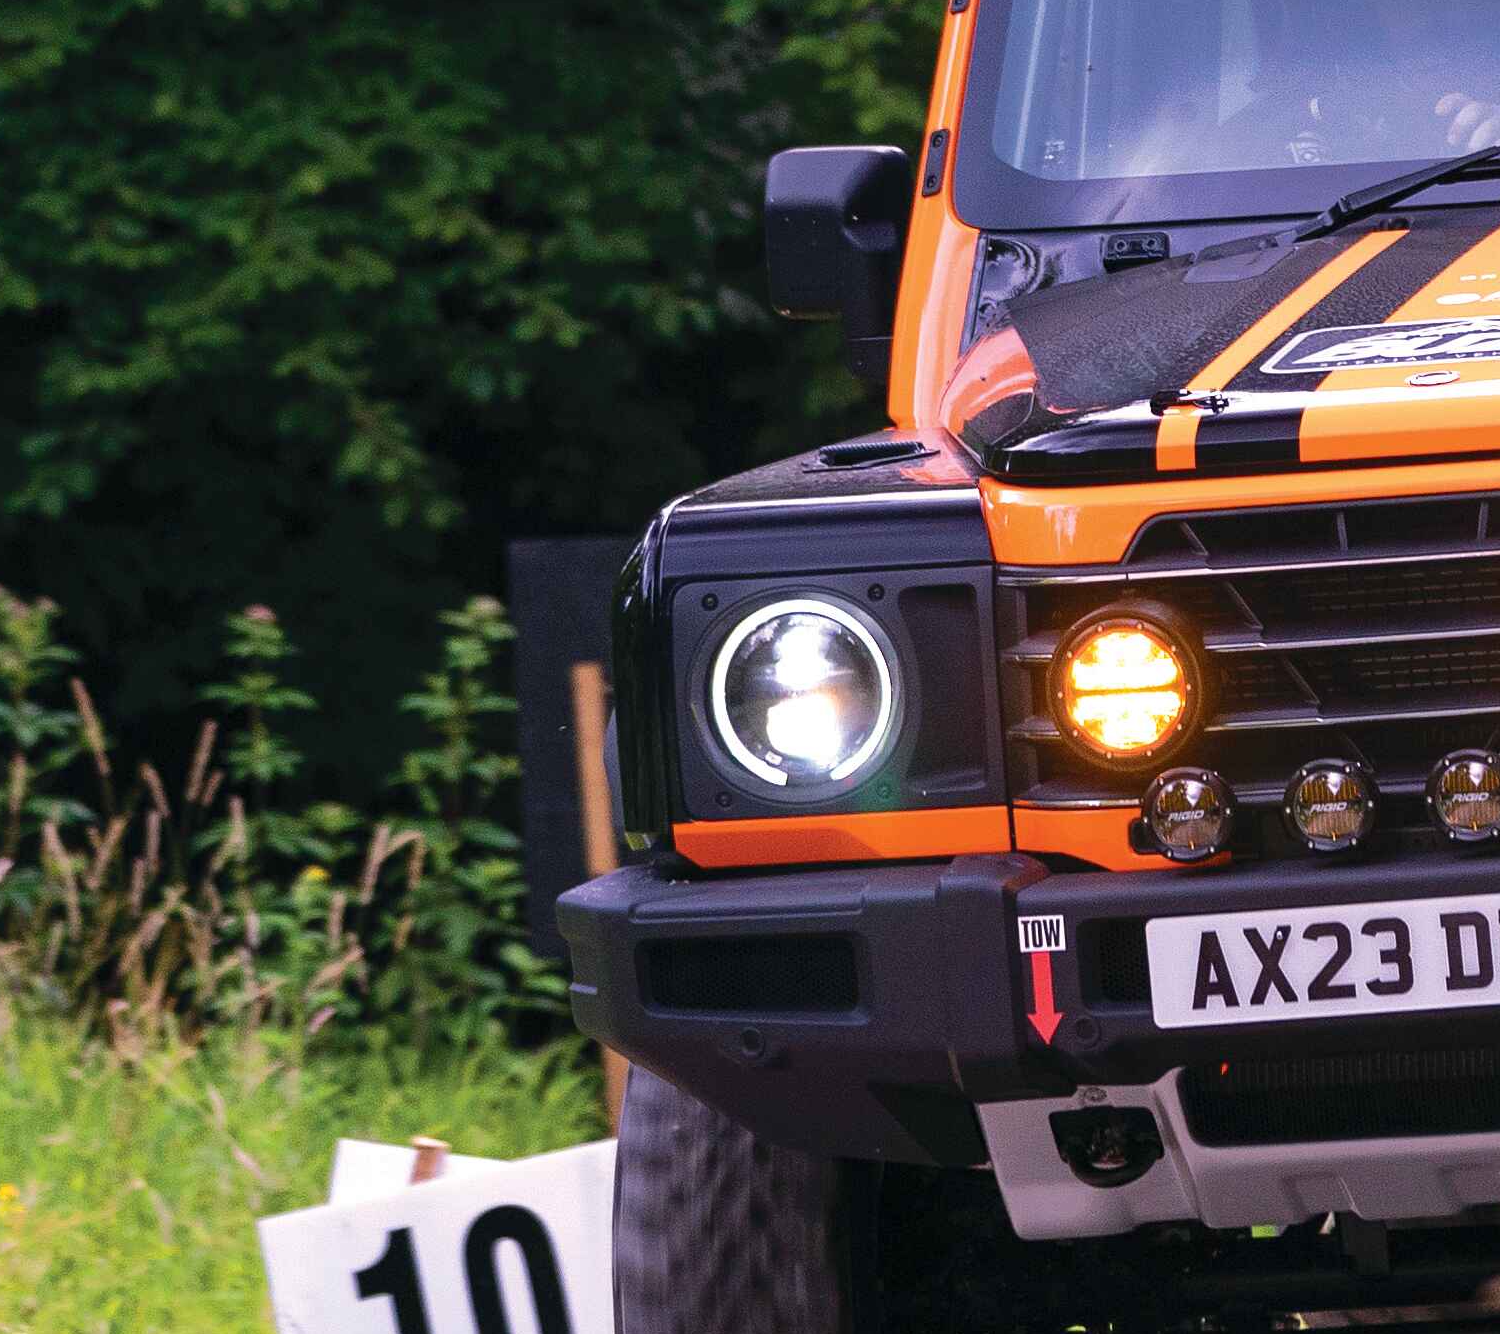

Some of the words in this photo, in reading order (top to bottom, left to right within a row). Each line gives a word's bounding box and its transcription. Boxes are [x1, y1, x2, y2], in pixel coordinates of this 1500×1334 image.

[1451, 790, 1490, 803] RIGID
[1310, 800, 1349, 815] RIGID
[1167, 809, 1206, 822] RIGID
[1021, 918, 1060, 949] TOW
[1191, 917, 1414, 1010] AX23
